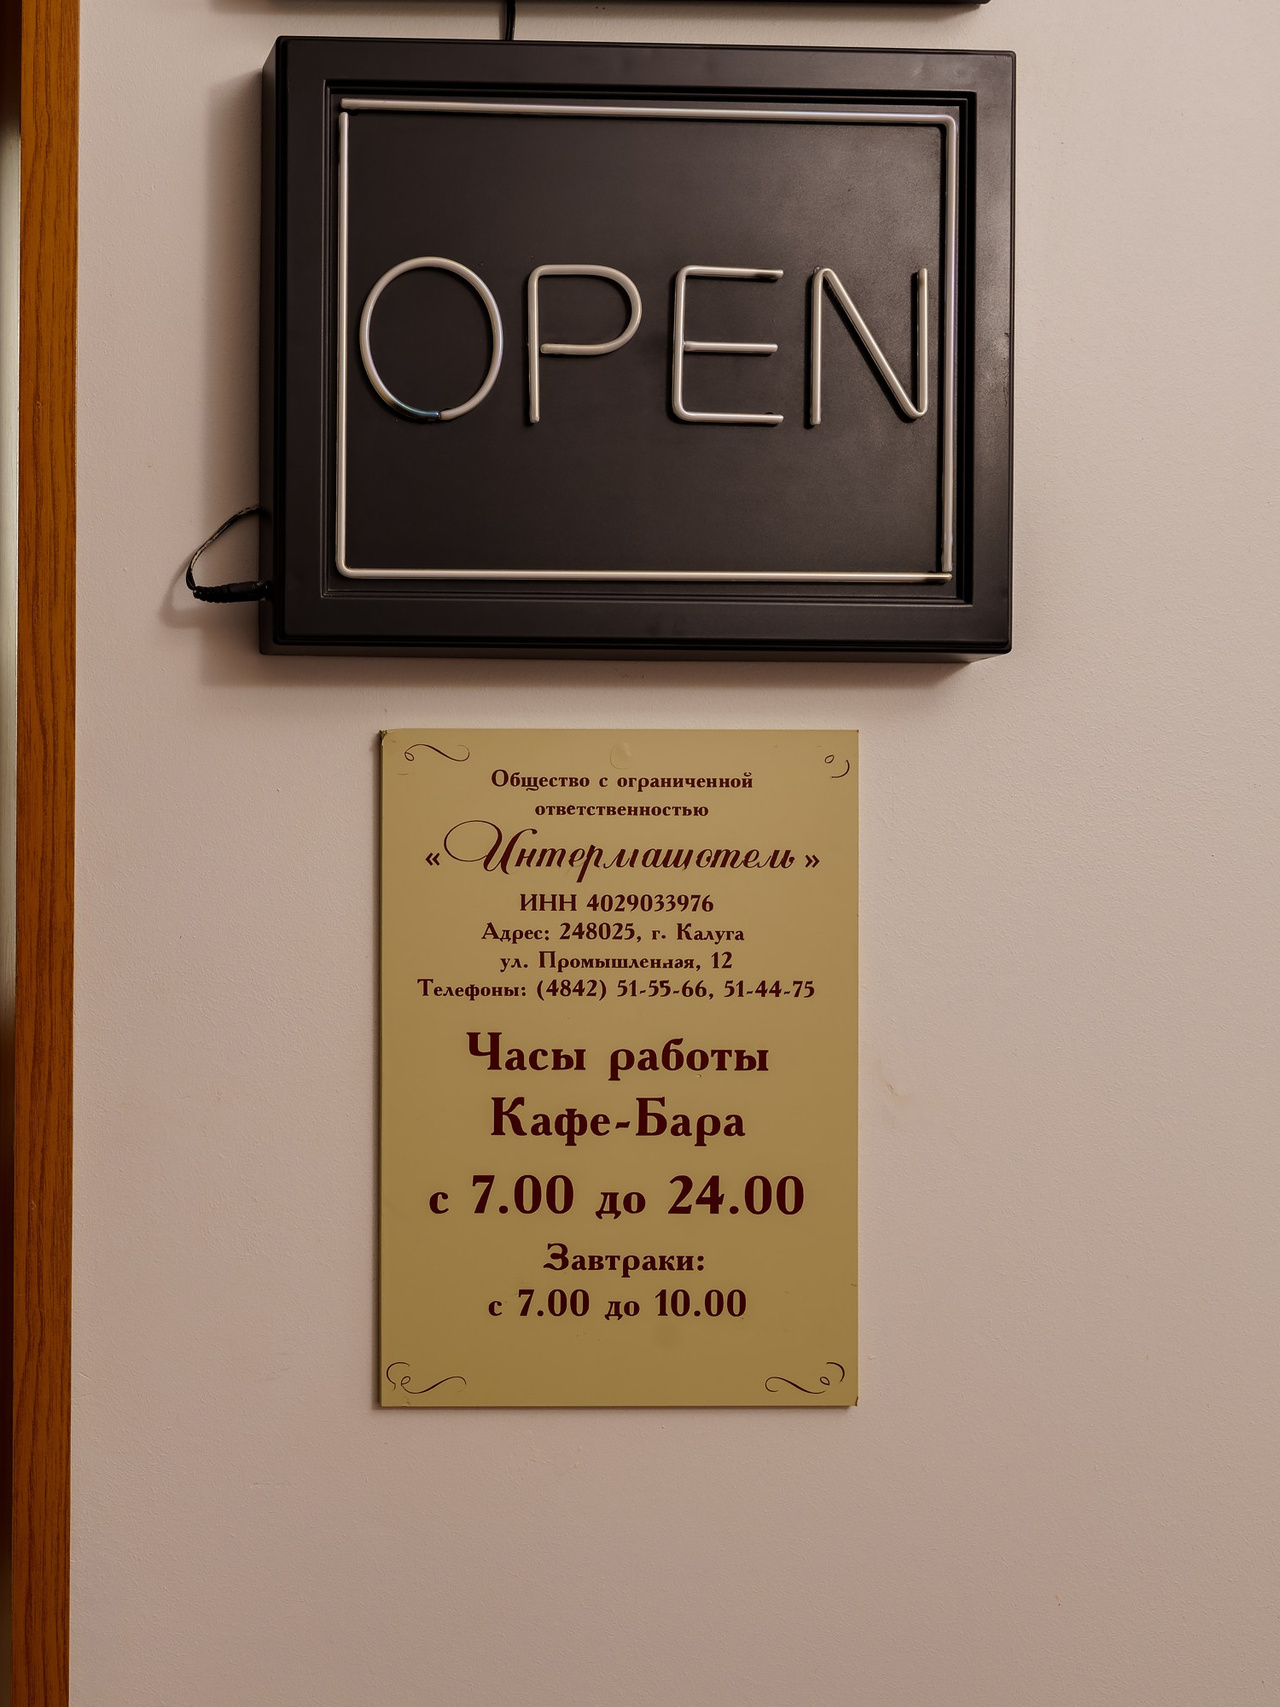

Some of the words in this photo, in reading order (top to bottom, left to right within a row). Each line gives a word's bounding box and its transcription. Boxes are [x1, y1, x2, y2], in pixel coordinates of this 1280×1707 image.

[359, 256, 928, 428] OPEN
[489, 767, 592, 793] Общество
[597, 775, 610, 789] с
[615, 770, 754, 794] ограниченной
[533, 803, 710, 818] ответственностью
[518, 892, 579, 913] ИНН
[584, 892, 715, 914] 4029033976
[479, 920, 551, 946] Адрес:
[557, 920, 643, 944] 248025,
[650, 928, 668, 942] г.
[675, 921, 746, 947] Калуга
[498, 956, 530, 974] ул.
[537, 949, 702, 974] Промышленная,
[709, 949, 734, 970] 12
[415, 977, 528, 1003] Телефоны:
[535, 977, 608, 1003] (4842)
[615, 978, 715, 1002] 51-55-66,
[722, 978, 816, 1000] 51-44-75
[464, 1030, 588, 1073] Часы
[606, 1036, 771, 1083] работы
[489, 1095, 747, 1148] Кафе-Бара
[427, 1190, 451, 1216] с
[470, 1173, 576, 1216] 7.00
[593, 1190, 648, 1221] до
[666, 1173, 806, 1217] 24.00
[541, 1241, 706, 1280] Завтраки:
[486, 1299, 504, 1318] с
[517, 1287, 591, 1318] 7.00
[602, 1299, 642, 1322] до
[653, 1287, 748, 1321] 10.00
